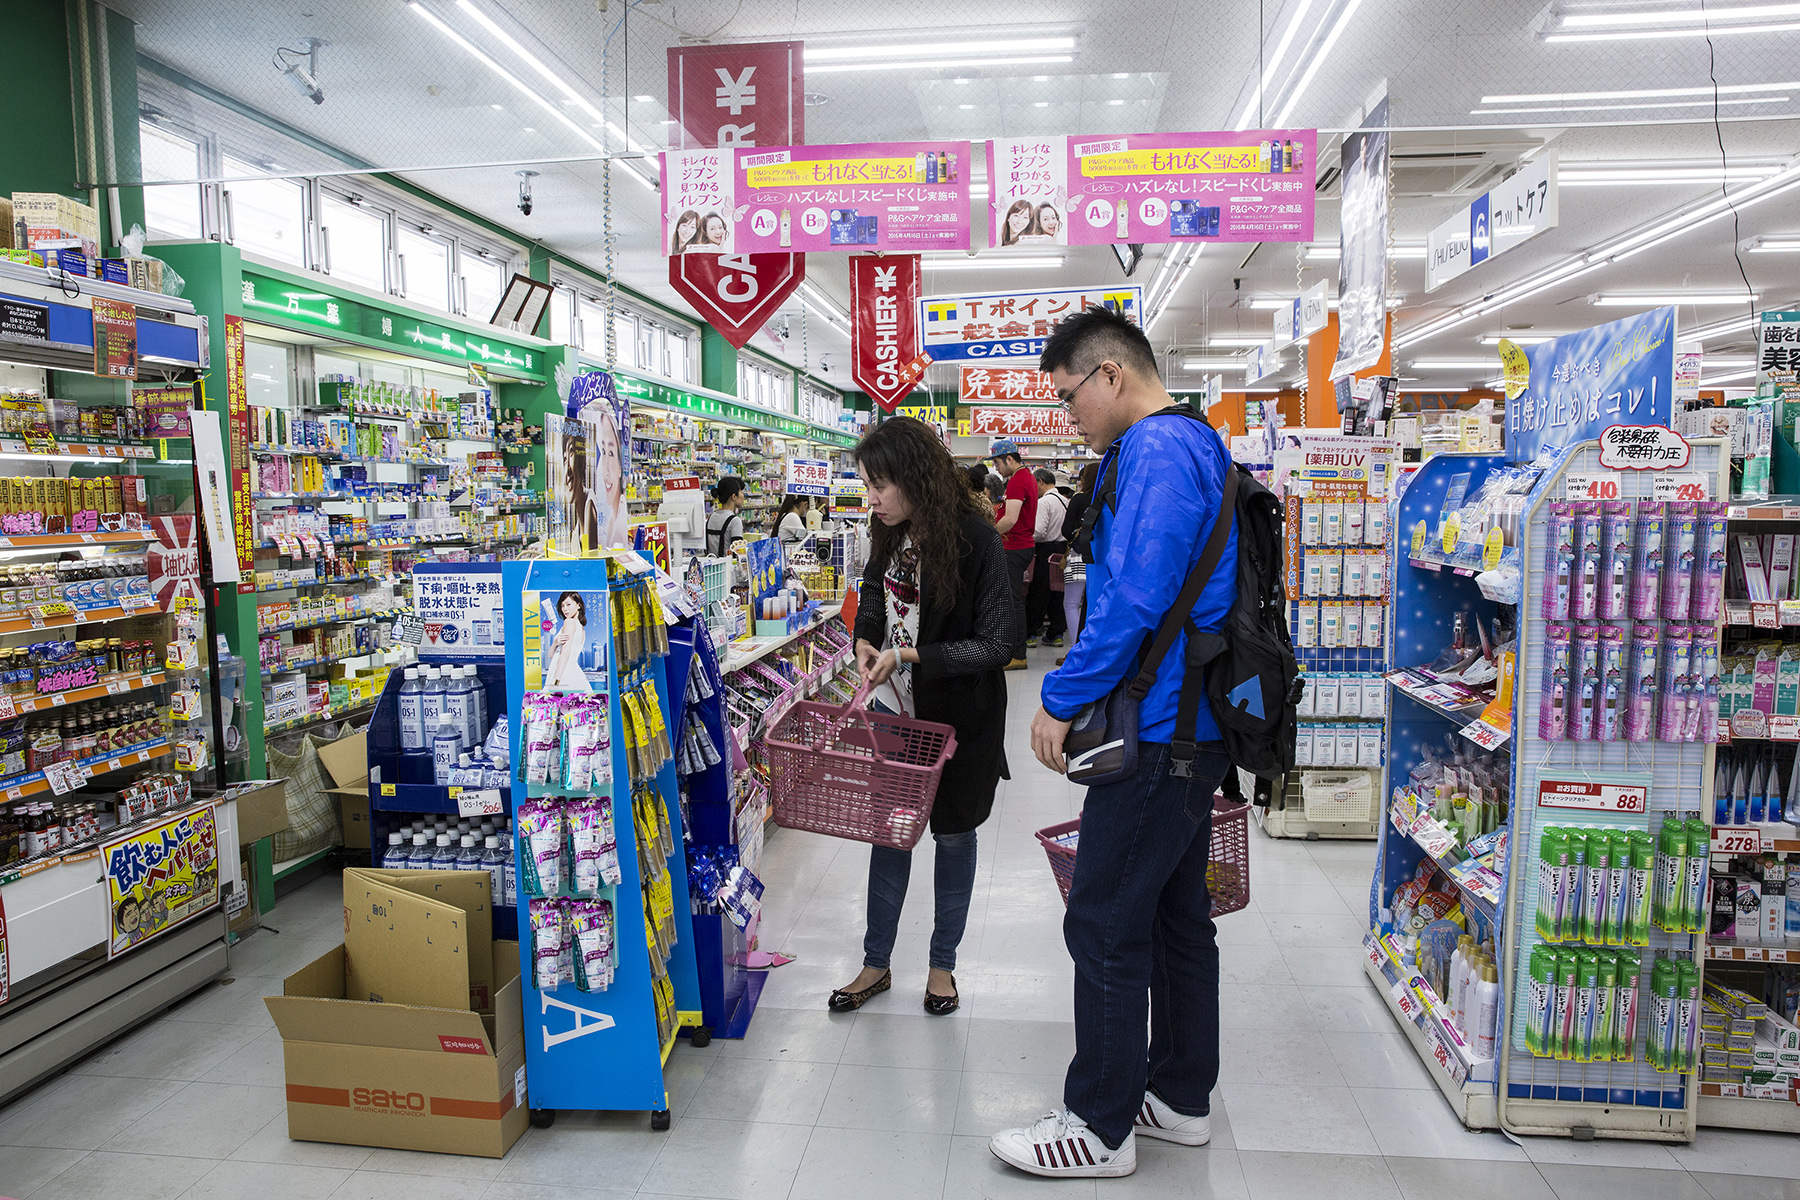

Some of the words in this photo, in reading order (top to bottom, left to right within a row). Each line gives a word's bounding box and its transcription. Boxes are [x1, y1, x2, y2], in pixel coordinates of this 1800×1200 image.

[1010, 143, 1050, 155] キレイな
[1081, 141, 1122, 154] 期間限定
[681, 155, 718, 167] キレイな
[747, 153, 785, 167] 期間限定
[1012, 156, 1049, 169] ジブン
[1150, 150, 1257, 171] もれなく当たる!
[682, 168, 717, 180] ジブン
[812, 162, 912, 182] もれなく当たる!
[1010, 170, 1051, 182] 見つかる
[681, 181, 719, 192] 見つかる
[1007, 184, 1055, 197] イレブン
[1092, 183, 1114, 192] レジにて
[678, 193, 723, 207] イレブン
[1495, 179, 1548, 232] フットケア
[1089, 206, 1110, 220] A賞
[1144, 204, 1165, 218] B賞
[1230, 204, 1302, 213] P&Gヘアケア全商品
[754, 216, 774, 229] A賞
[806, 214, 825, 228] B賞
[887, 214, 957, 223] P&Gヘアケア全商品
[1475, 212, 1486, 252] 6
[95, 306, 135, 320] 早く治したい
[874, 294, 900, 391] CASHIER
[1551, 356, 1601, 384] 今選ぶべき
[963, 368, 1034, 400] 免税
[1511, 375, 1657, 433] 日焼け止めはコレ!
[974, 410, 1029, 434] 免税
[1030, 411, 1052, 426] TAX
[1029, 426, 1076, 435] CASHIER
[1305, 453, 1365, 467] 【薬用】UV
[793, 465, 828, 480] 不免税
[795, 485, 826, 495] CASHIER
[1587, 481, 1618, 499] 410
[1675, 483, 1705, 500] 296
[1288, 497, 1297, 598] 赤ちゃんのデリケートな肌にも
[419, 597, 480, 609] 脱水状態に
[525, 607, 541, 667] ALLIE
[402, 707, 416, 717] OS-1
[424, 707, 438, 717] OS-1
[1562, 785, 1587, 794] お買得
[1616, 794, 1637, 809] 88
[1724, 837, 1753, 851] 278
[109, 816, 193, 894] 飲む人に
[146, 824, 214, 889] ヘパリーゼ
[165, 883, 188, 899] 女子会
[353, 1087, 426, 1111] sato
[353, 1105, 388, 1116] HEALTHCARE
[390, 1109, 426, 1118] INNOVATION
